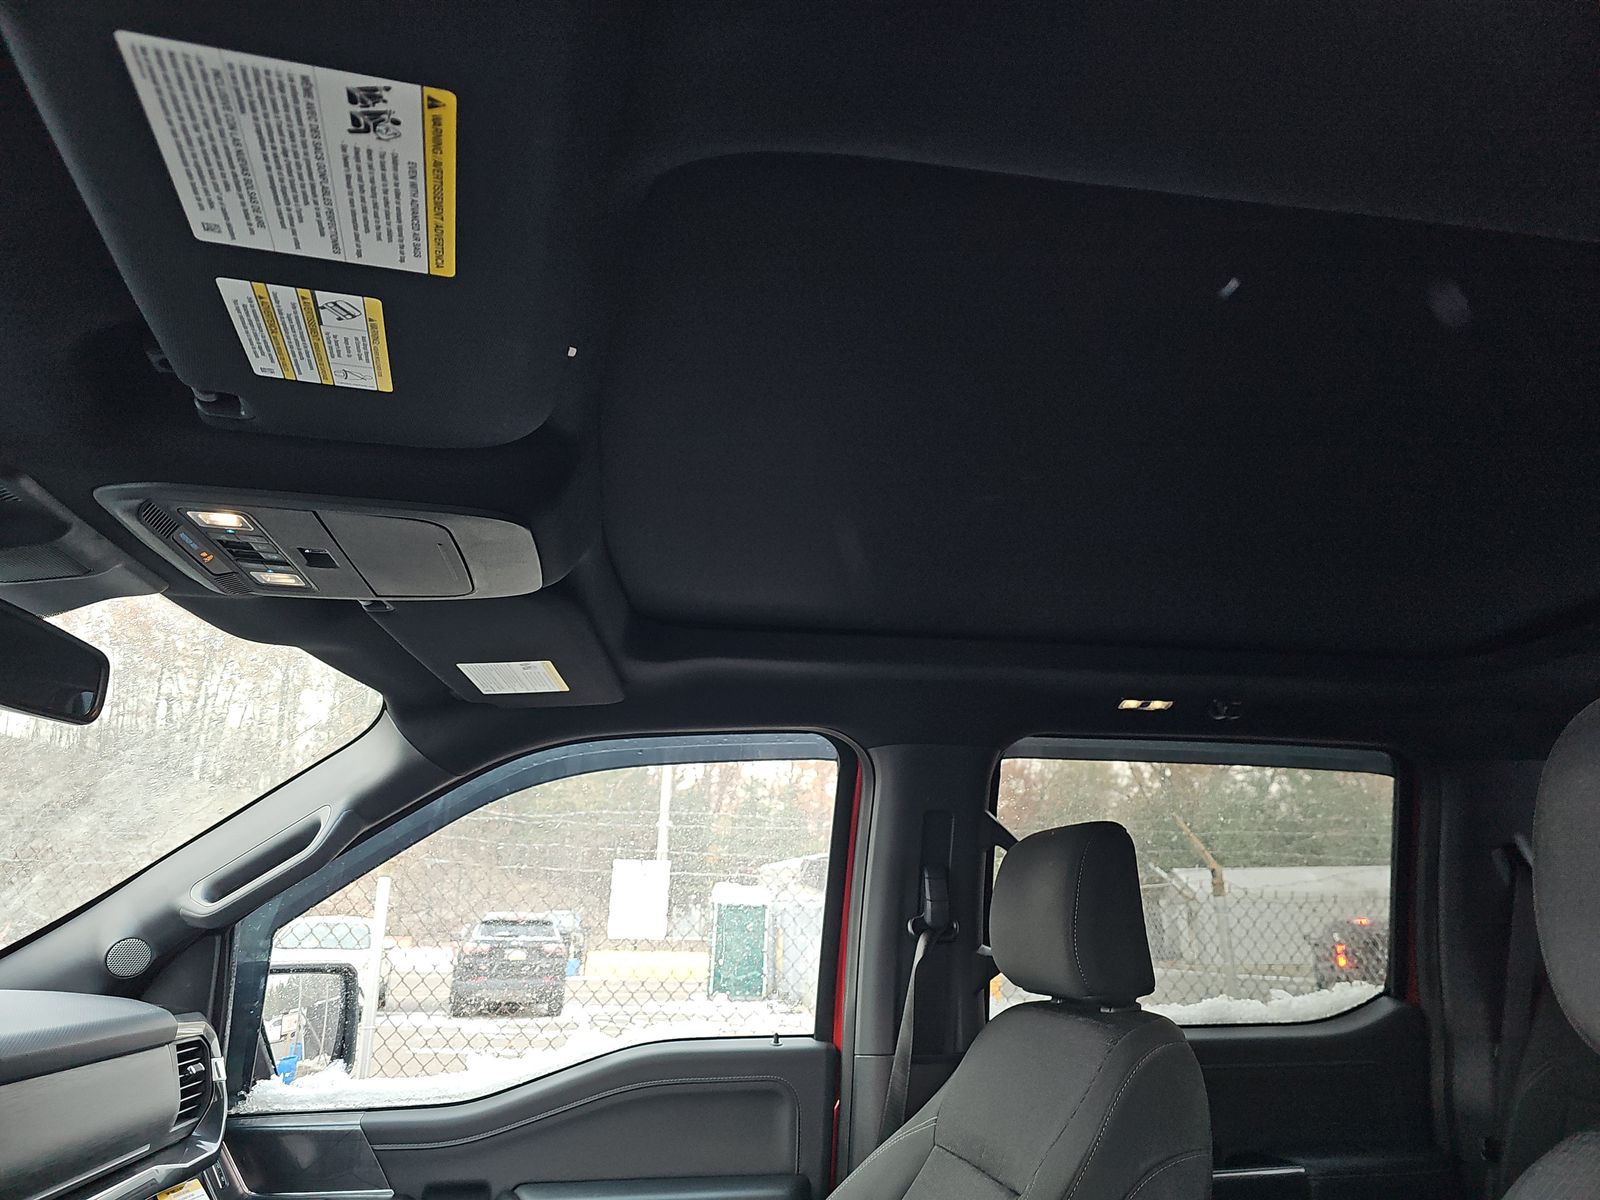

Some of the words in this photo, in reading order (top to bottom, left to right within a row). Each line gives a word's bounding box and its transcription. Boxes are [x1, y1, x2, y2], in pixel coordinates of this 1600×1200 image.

[212, 69, 233, 112] INCLUSIVE
[305, 102, 319, 122] AVEC
[225, 114, 238, 131] CON
[309, 123, 322, 140] DES
[230, 132, 243, 147] LAS
[431, 114, 442, 155] WARNING
[312, 140, 326, 161] SACS
[235, 148, 251, 177] NUEVAS
[407, 161, 418, 180] EVEN
[243, 178, 259, 204] BOLSAS
[316, 161, 334, 206] GONFLABLES
[408, 181, 419, 198] WITH
[433, 159, 443, 222] AVERTISSEMENT
[251, 205, 262, 214] DE
[409, 199, 420, 231] ADVANCED
[254, 215, 266, 229] AIRE
[411, 232, 421, 242] AIR
[412, 242, 422, 258] BAGS
